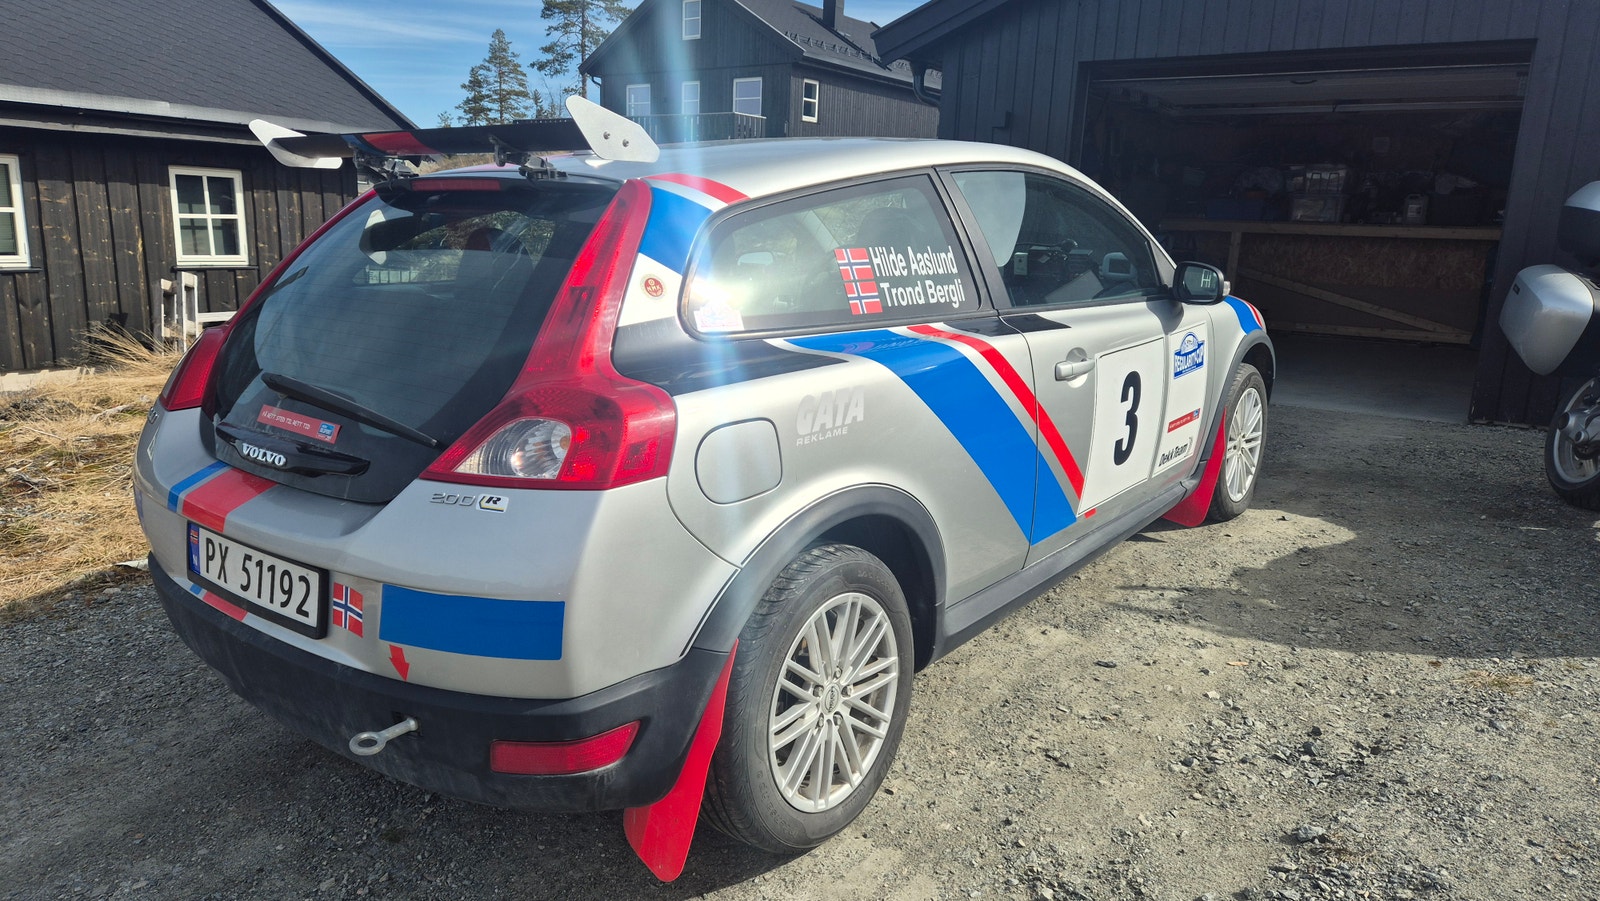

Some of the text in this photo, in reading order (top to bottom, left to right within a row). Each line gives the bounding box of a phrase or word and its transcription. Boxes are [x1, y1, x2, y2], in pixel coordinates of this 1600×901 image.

[869, 246, 958, 276] Hilde Aaslund
[880, 279, 965, 308] Trond Bergli
[796, 386, 864, 436] GATA
[1113, 370, 1142, 466] 3
[796, 427, 849, 447] REKLAME
[242, 443, 286, 466] VOLVO
[430, 492, 477, 506] 200
[486, 496, 502, 504] R
[205, 537, 311, 619] PX 51192
